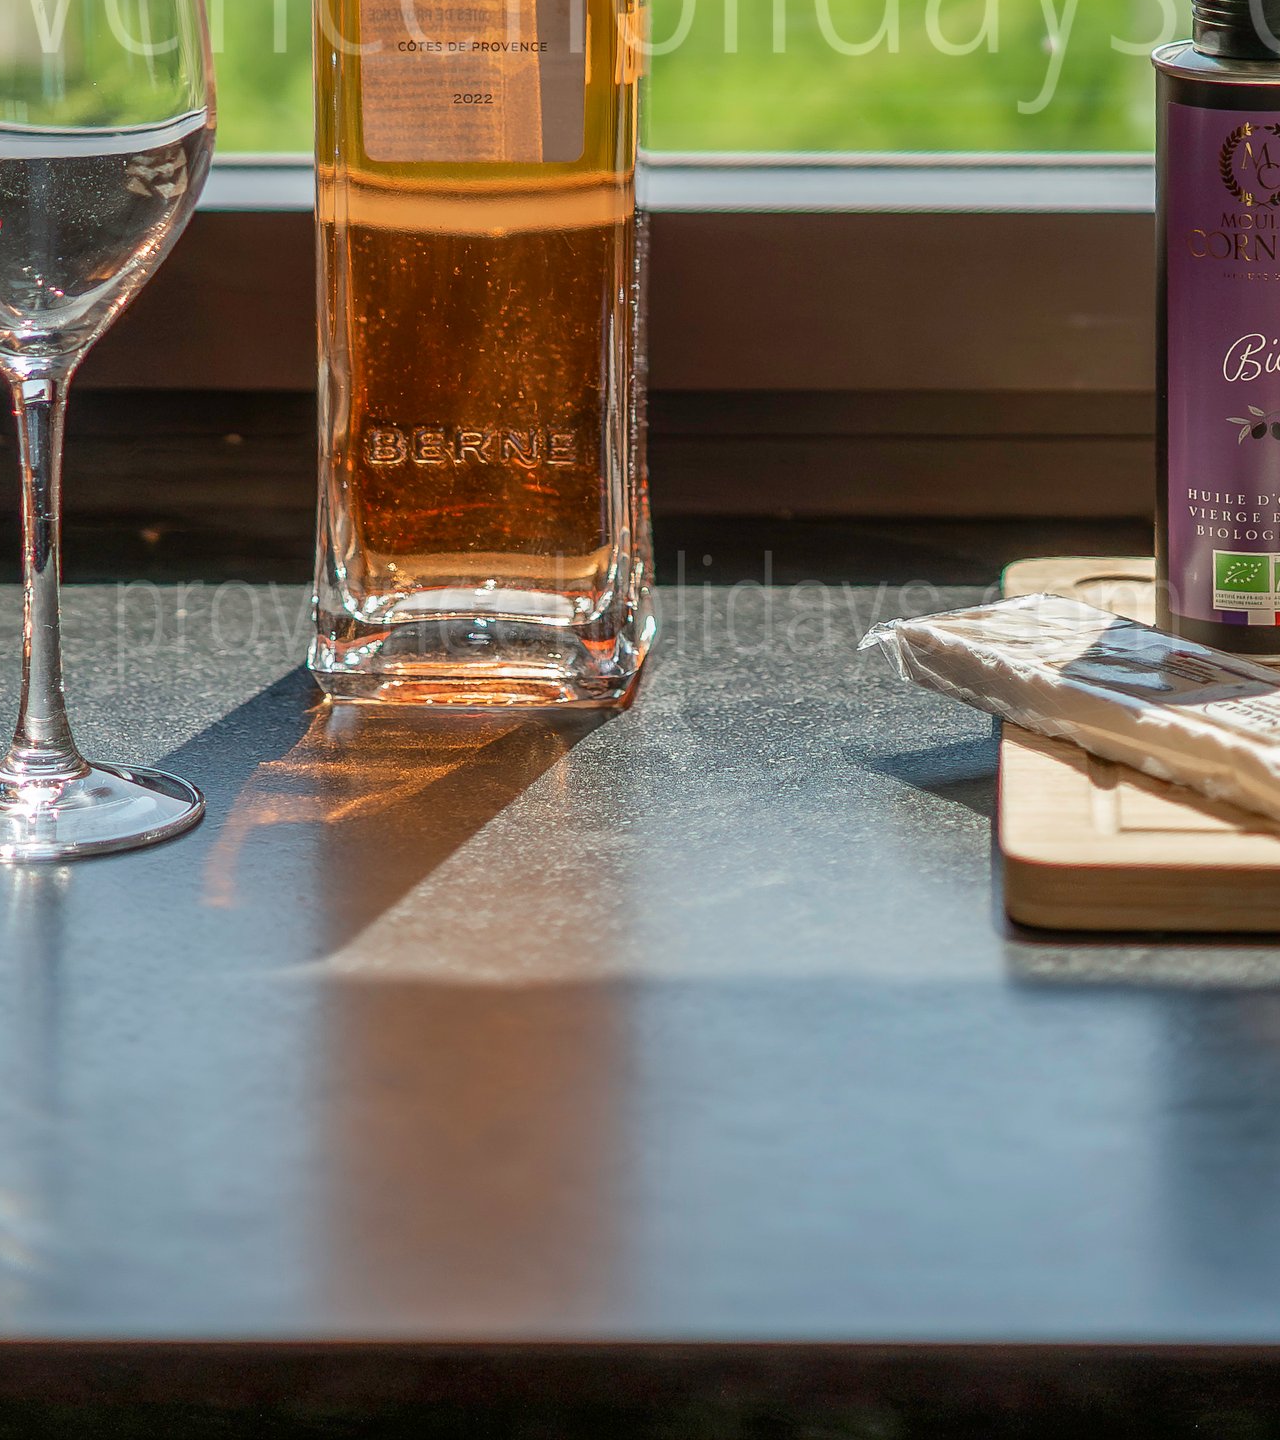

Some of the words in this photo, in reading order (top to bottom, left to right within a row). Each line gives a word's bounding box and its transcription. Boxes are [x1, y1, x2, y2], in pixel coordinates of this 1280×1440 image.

[398, 40, 442, 52] CÔTES
[448, 41, 466, 52] DE
[472, 41, 548, 52] PROVENCE
[453, 93, 494, 104] 2022
[365, 426, 577, 468] BERNE
[1188, 488, 1246, 505] HUILE
[1189, 506, 1261, 522] VIERGE
